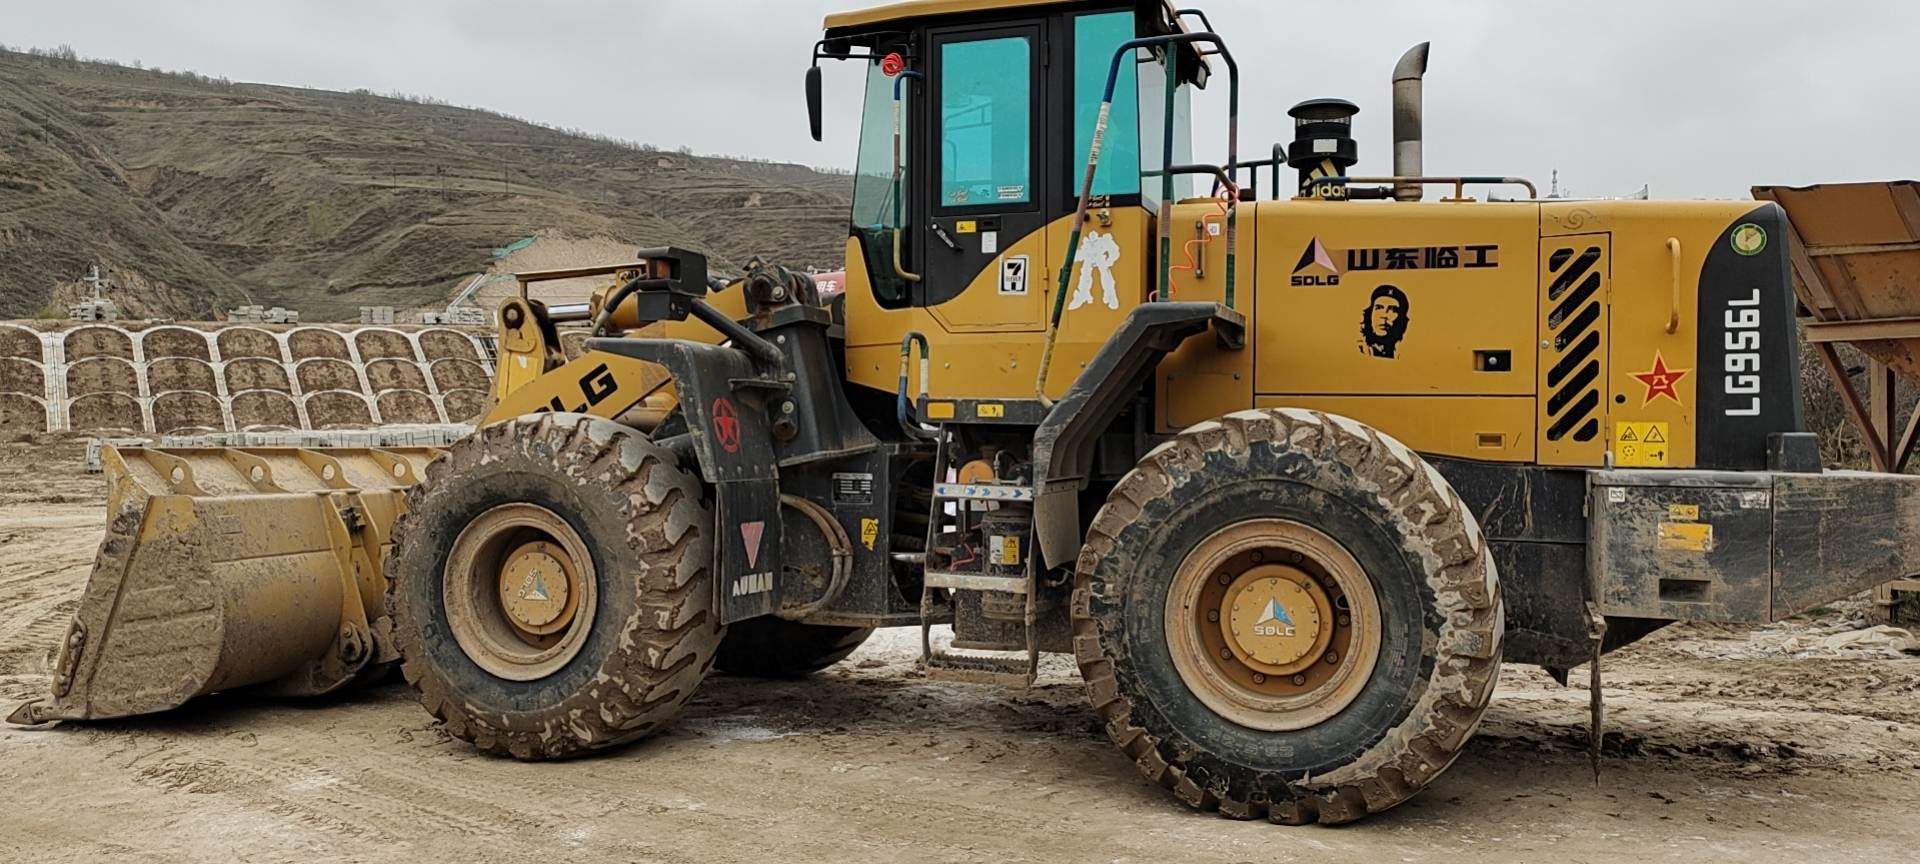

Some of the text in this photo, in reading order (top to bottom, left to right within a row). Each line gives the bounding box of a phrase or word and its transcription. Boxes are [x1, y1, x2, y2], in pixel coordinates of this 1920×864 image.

[1347, 244, 1499, 272] 山东临工
[1291, 275, 1339, 287] SDLG
[1724, 288, 1760, 416] LG956L
[1254, 626, 1297, 637] SDLG
